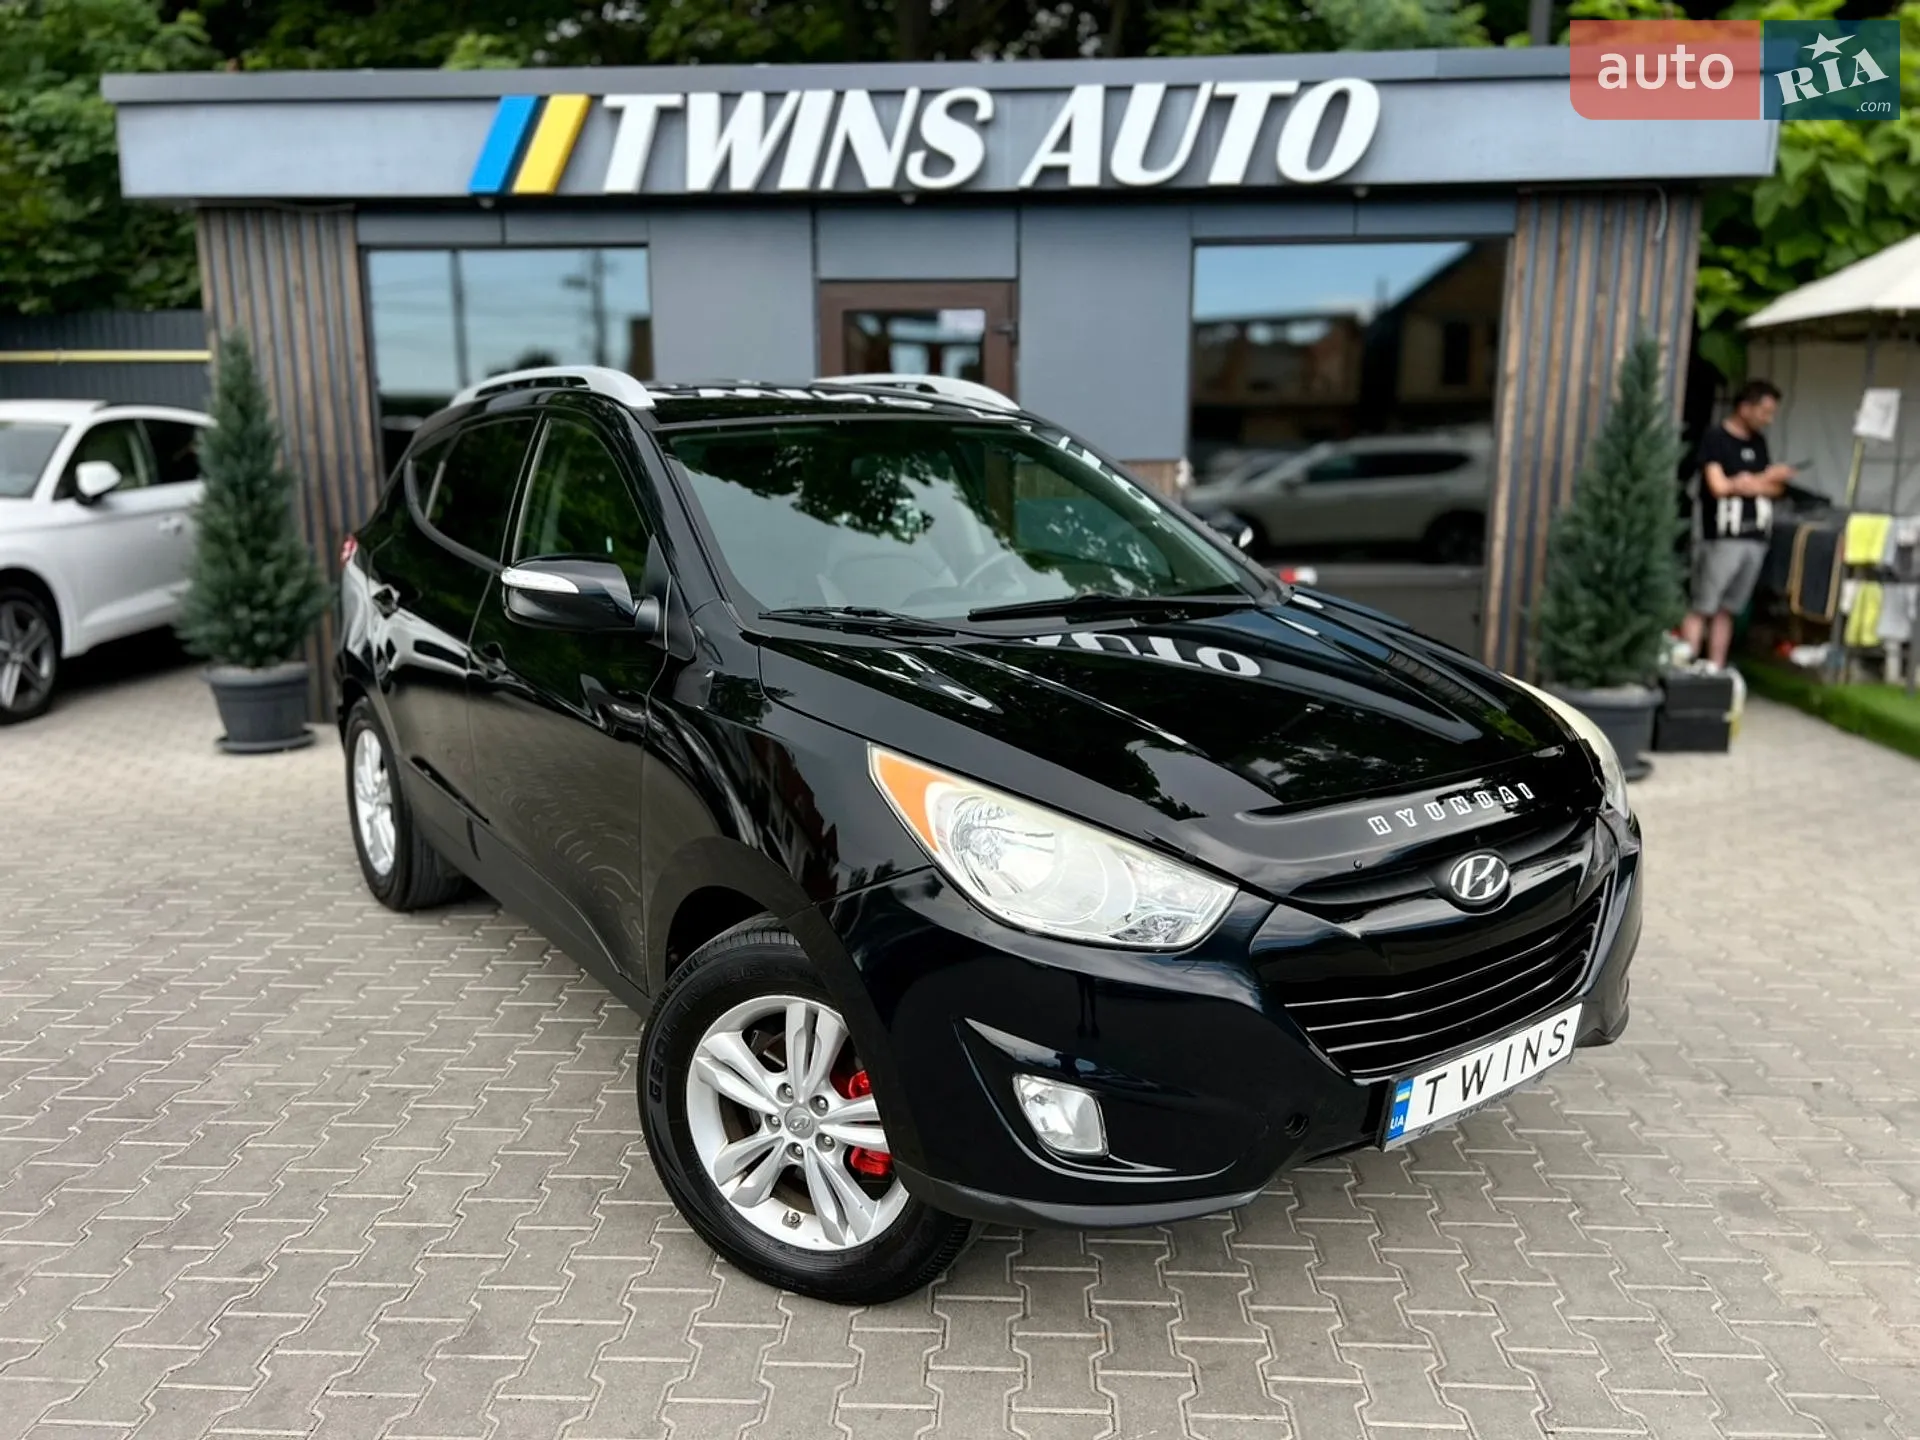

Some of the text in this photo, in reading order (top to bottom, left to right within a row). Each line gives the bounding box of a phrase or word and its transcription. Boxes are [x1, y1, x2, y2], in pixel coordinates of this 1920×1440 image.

[602, 77, 1380, 193] TWINS AUTO
[1367, 782, 1535, 835] HYUNDAI
[1425, 1018, 1568, 1115] TWINS
[1391, 1115, 1404, 1129] UA
